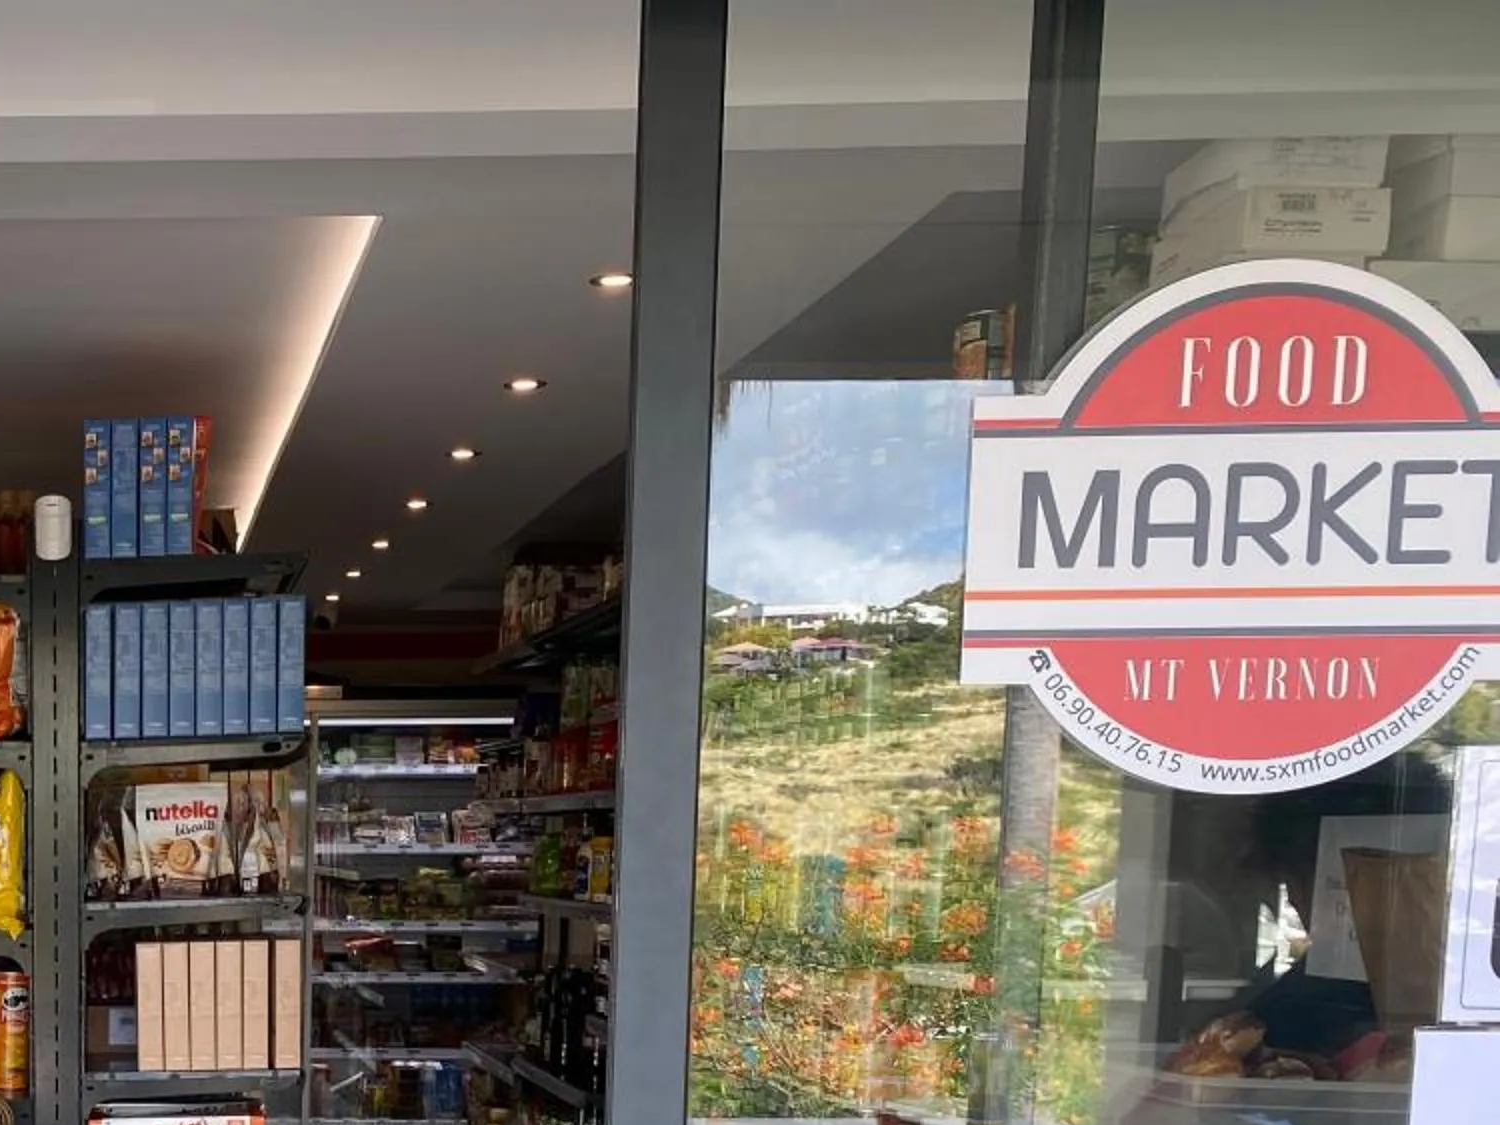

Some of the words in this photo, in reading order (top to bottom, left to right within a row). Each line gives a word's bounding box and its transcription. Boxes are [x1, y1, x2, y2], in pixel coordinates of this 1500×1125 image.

[1178, 334, 1369, 408] FOOD
[1017, 459, 1500, 569] MARKET
[1043, 672, 1183, 774] 06.90.40.76.15
[1200, 645, 1481, 783] www.sxmfoodmarket.com
[1124, 658, 1184, 701] MT
[1209, 656, 1381, 700] VERNON
[146, 800, 219, 821] nutella
